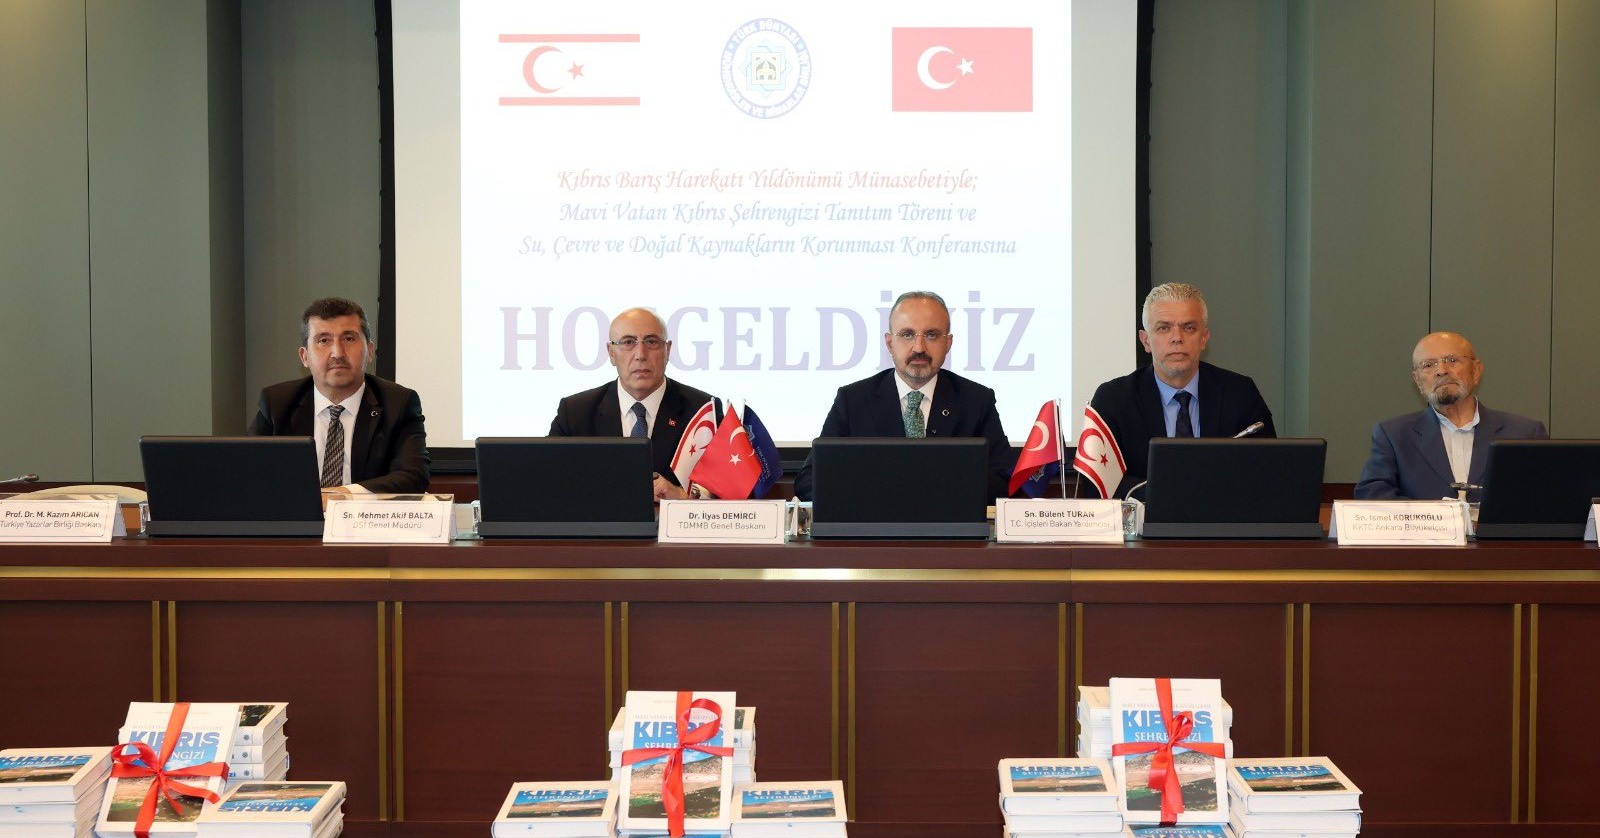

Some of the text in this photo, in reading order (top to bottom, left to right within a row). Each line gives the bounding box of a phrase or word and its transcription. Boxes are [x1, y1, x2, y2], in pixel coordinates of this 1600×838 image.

[557, 168, 979, 195] Kıbrıs Barış Harekatı Yıldönümü Münasebetiyle;
[559, 201, 977, 227] Mavi Vatan Kıbrıs Şehrengizi Tanıtım Töreni ve
[518, 232, 1017, 260] Su, Çevre ve Doğal Kaynakların Korunması Konferansına
[500, 290, 1036, 373] HOGELDİİZ
[5, 510, 23, 518] Prof.
[342, 511, 355, 519] Sn.
[357, 511, 390, 519] Mehmet
[390, 511, 407, 519] Akif
[688, 511, 757, 521] Dr. İlyas DEMİRCİ
[1024, 510, 1095, 518] Sn. Bülent TURAN
[368, 521, 390, 529] Genel
[392, 521, 422, 529] Müdürü
[710, 521, 733, 529] Genel
[1049, 519, 1073, 528] Bakan
[1122, 710, 1213, 727] KIBS
